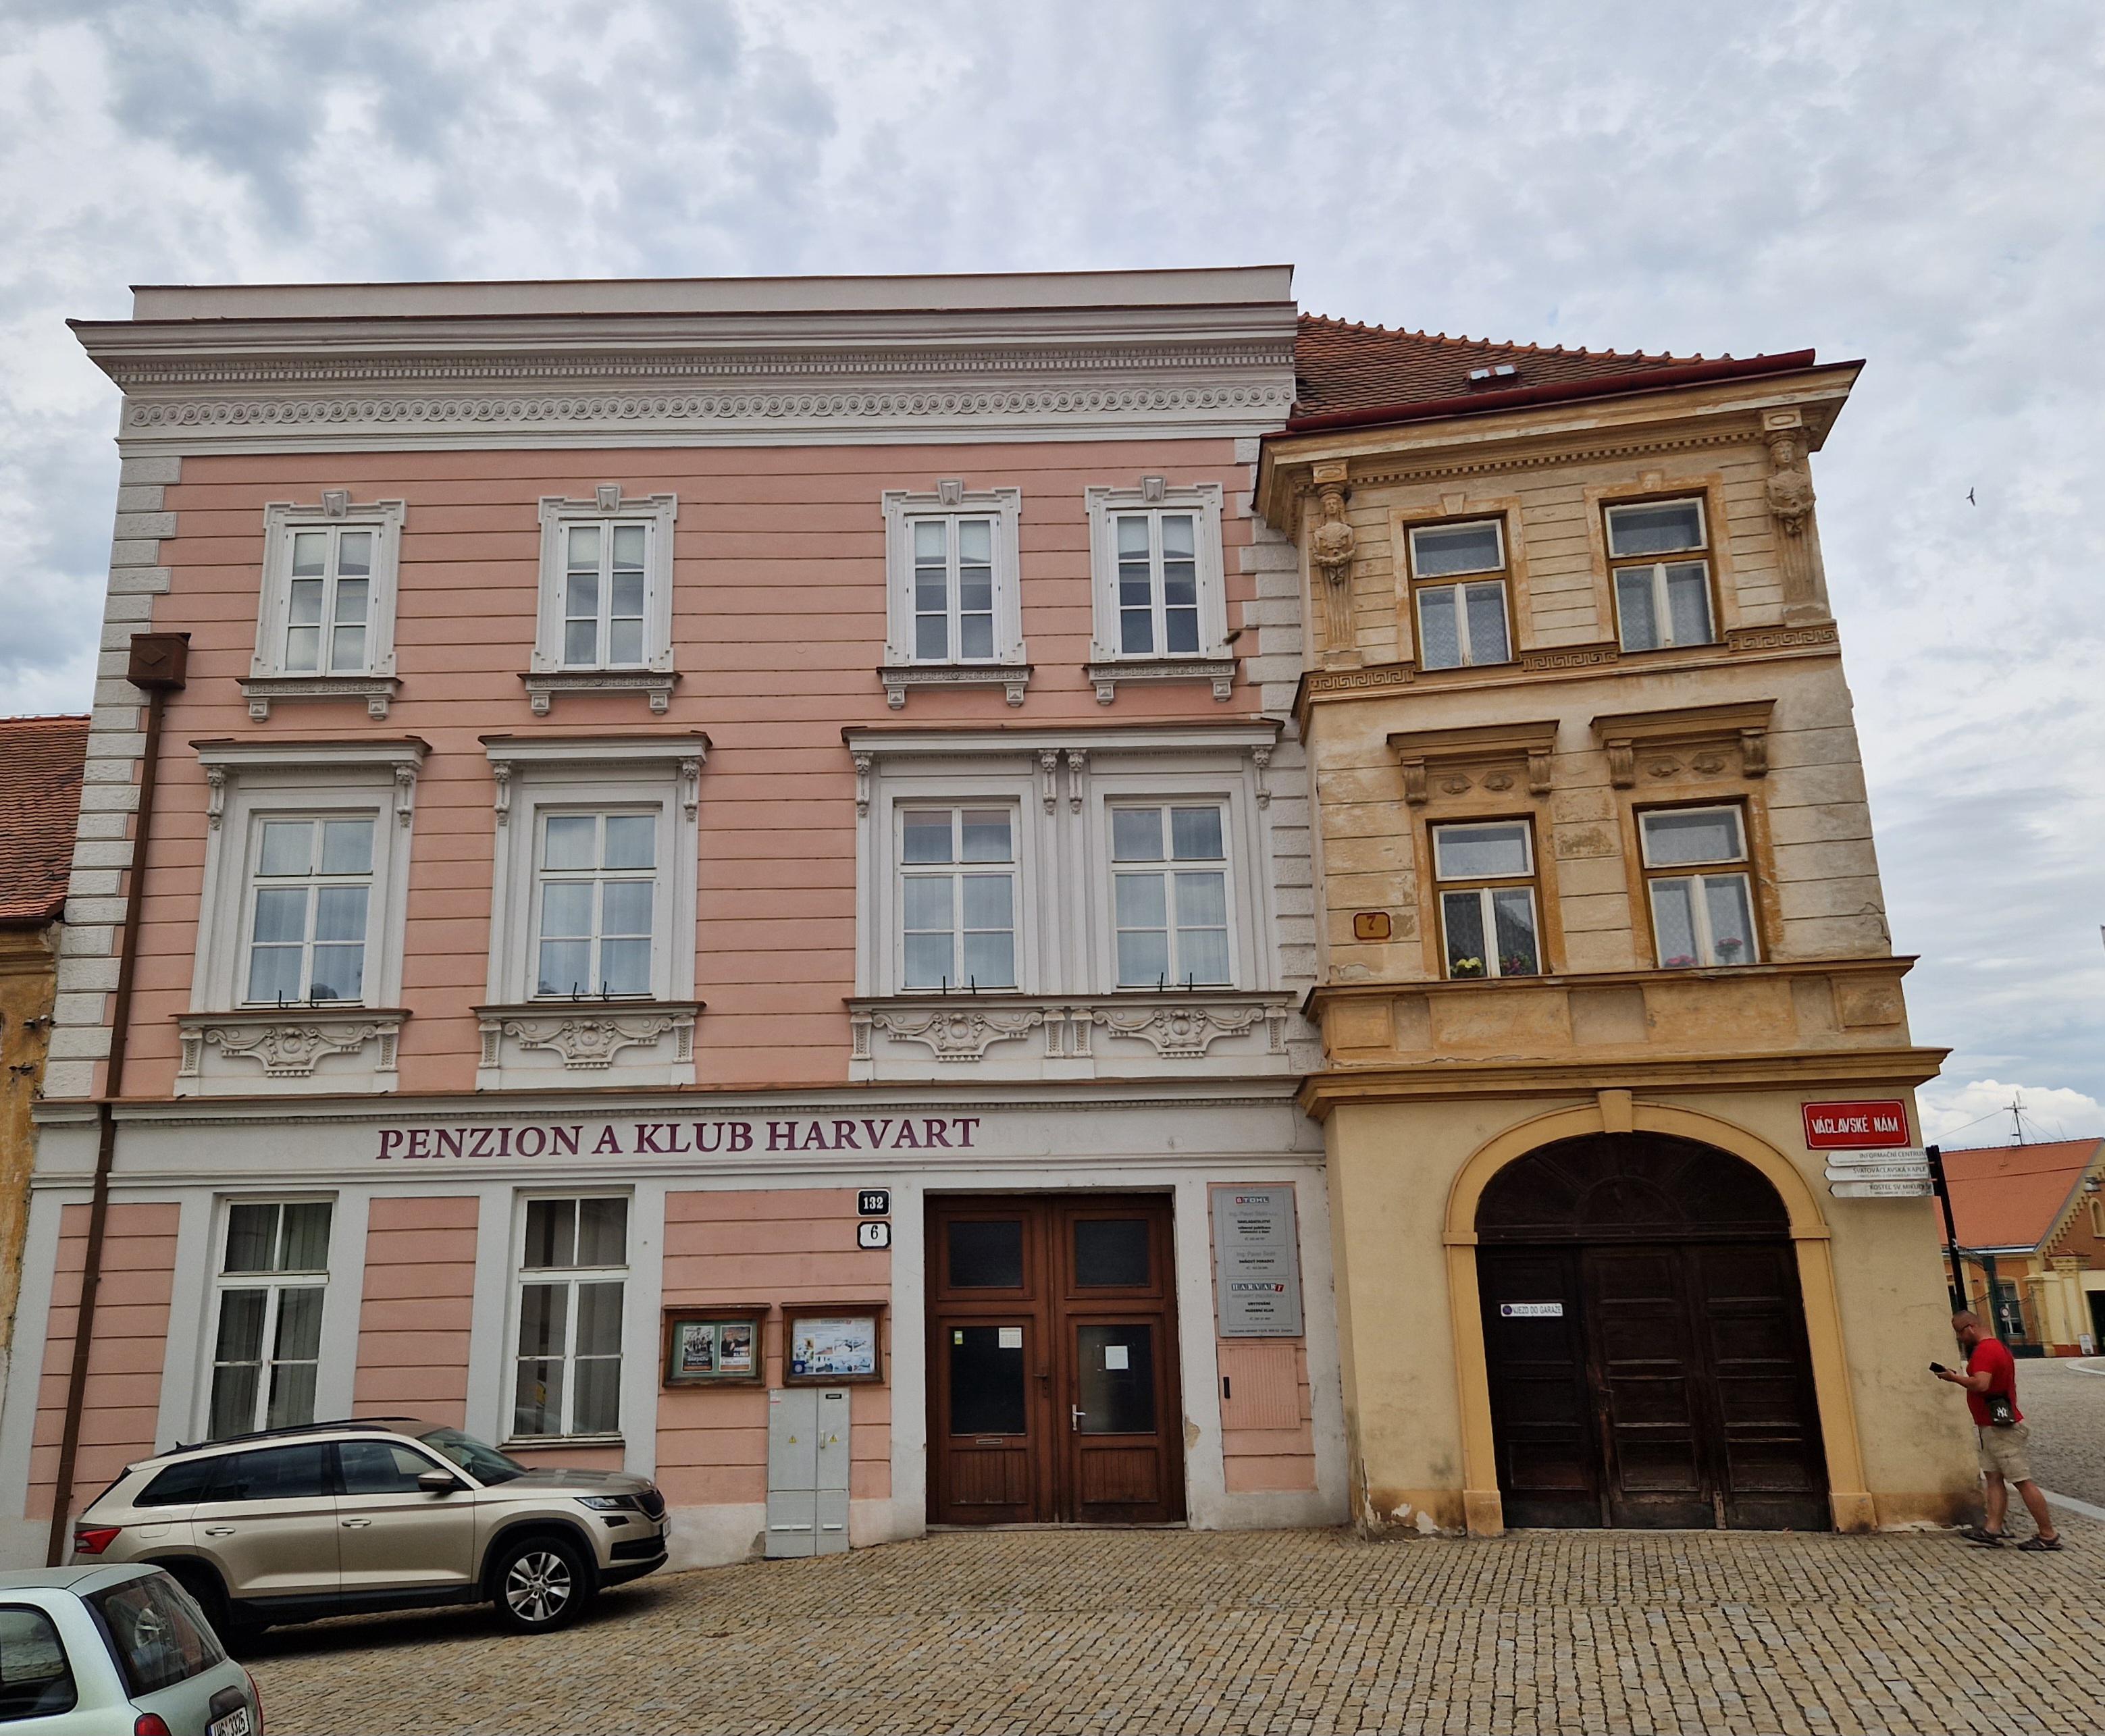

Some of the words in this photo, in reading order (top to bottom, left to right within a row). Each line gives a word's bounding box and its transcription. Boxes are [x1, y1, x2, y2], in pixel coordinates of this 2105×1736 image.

[1366, 914, 1376, 930] 7
[1811, 1114, 1869, 1134] VÁCLAVSKÉ
[375, 1125, 583, 1160] PENZION
[592, 1125, 623, 1155] A
[633, 1121, 754, 1154] KLUB
[764, 1117, 980, 1151] HARVART
[1859, 1150, 1897, 1159] INFORMAČNÍ
[1898, 1149, 1927, 1158] CENTRUM
[1852, 1165, 1906, 1174] SVATOVÁCLAVSKÁ
[863, 1196, 884, 1210] 132
[870, 1225, 879, 1240] 6
[1232, 1283, 1284, 1292] HARVART
[1530, 1306, 1539, 1314] DO
[229, 1711, 245, 1736] 3325
